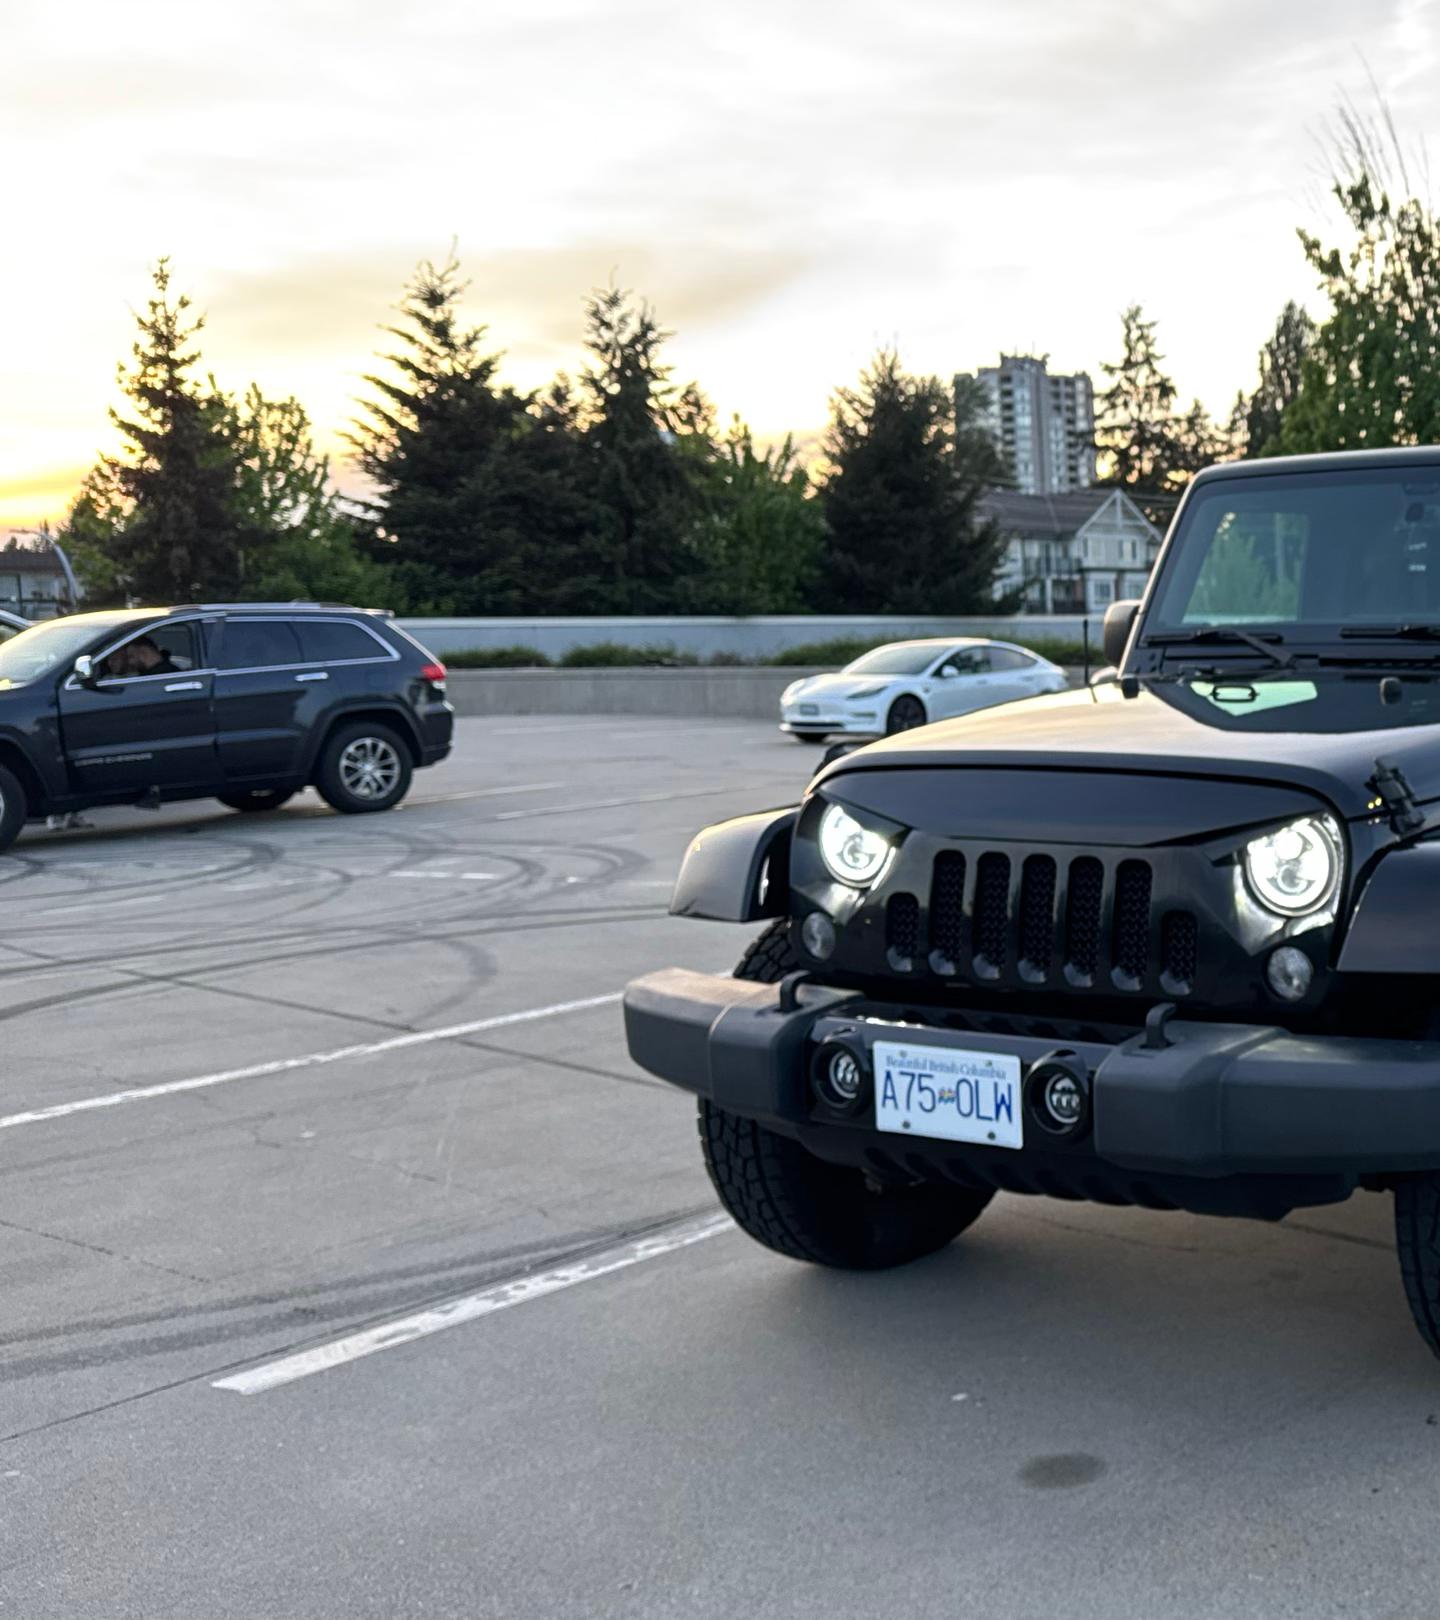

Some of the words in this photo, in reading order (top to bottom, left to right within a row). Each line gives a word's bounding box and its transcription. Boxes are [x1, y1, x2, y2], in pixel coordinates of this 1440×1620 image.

[885, 1055, 928, 1070] Beautiful
[929, 1060, 957, 1074] British
[959, 1063, 1007, 1080] Columbia
[882, 1070, 936, 1113] A75
